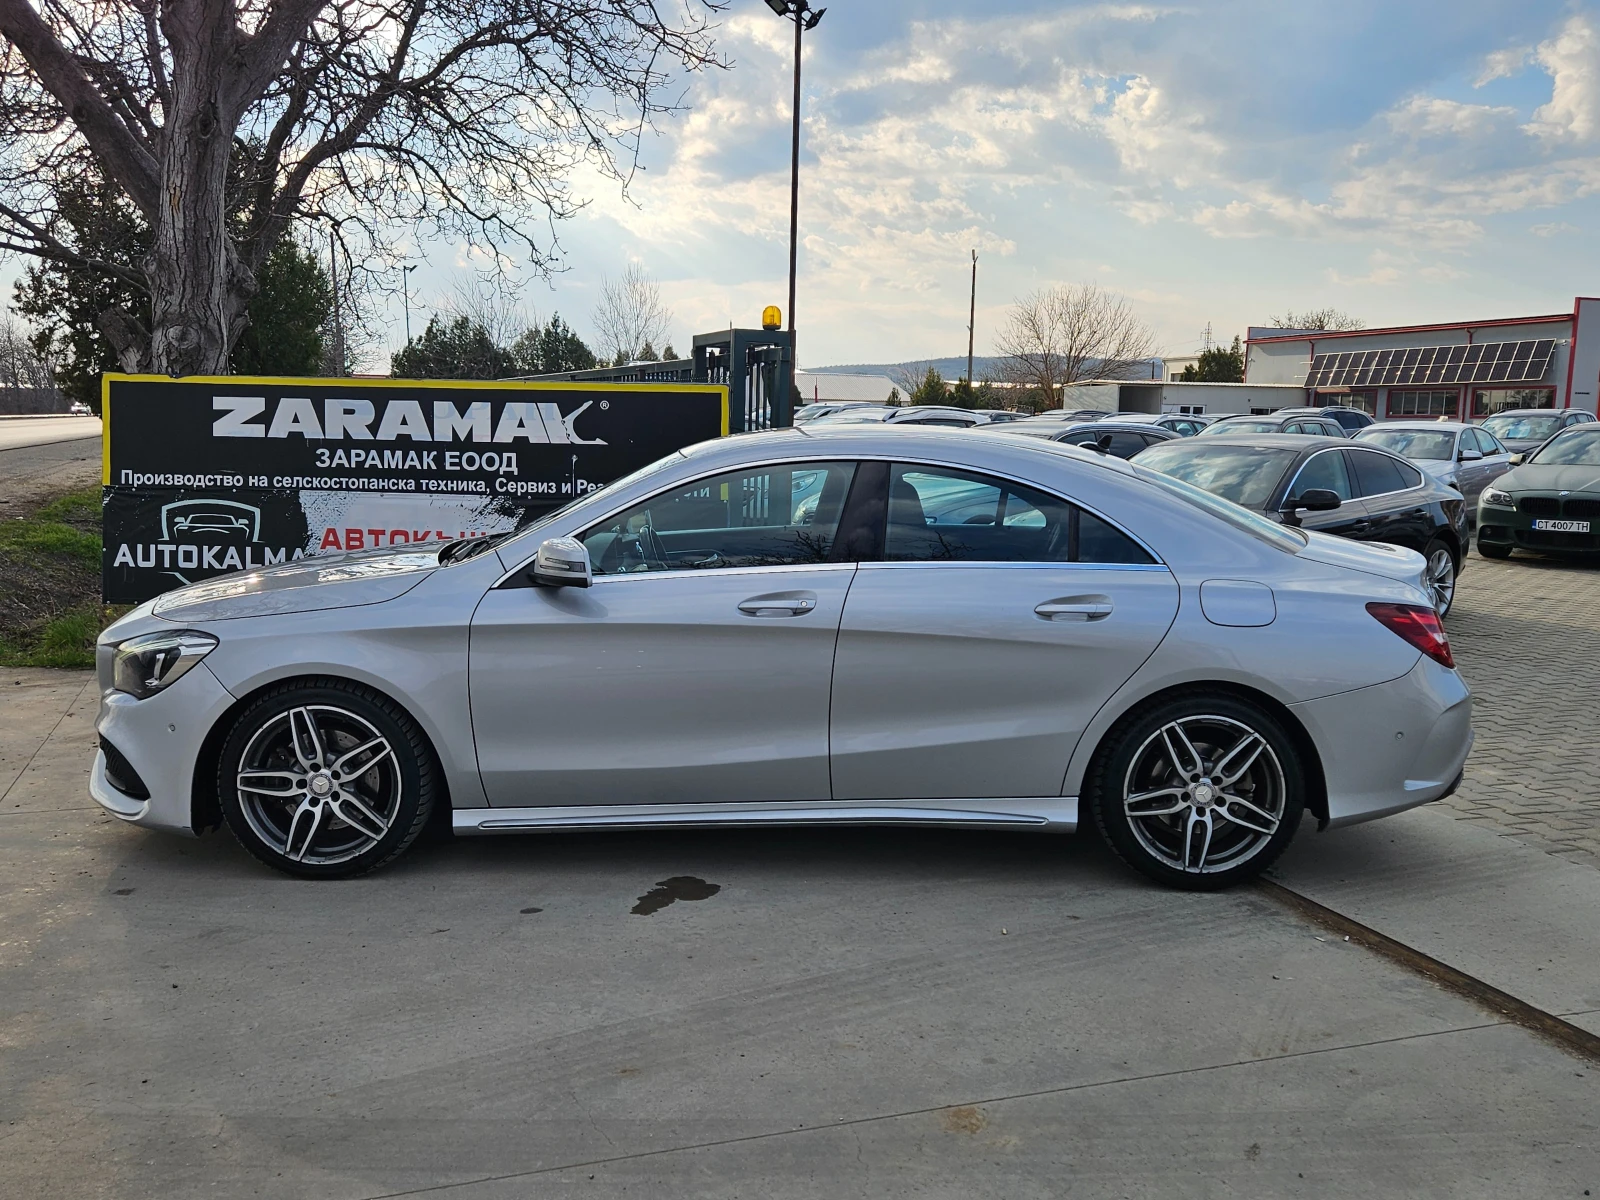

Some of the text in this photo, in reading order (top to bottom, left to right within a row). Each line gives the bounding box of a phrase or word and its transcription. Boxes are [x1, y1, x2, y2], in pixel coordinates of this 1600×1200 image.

[315, 448, 518, 475] ЗАРАМАК ЕООД
[121, 469, 243, 488] Производство
[248, 475, 268, 487] на
[273, 475, 415, 490] селскостопанска
[420, 479, 490, 495] техника,
[495, 477, 556, 496] Сервиз
[561, 482, 572, 494] и
[1537, 520, 1589, 532] CT 4007 TH
